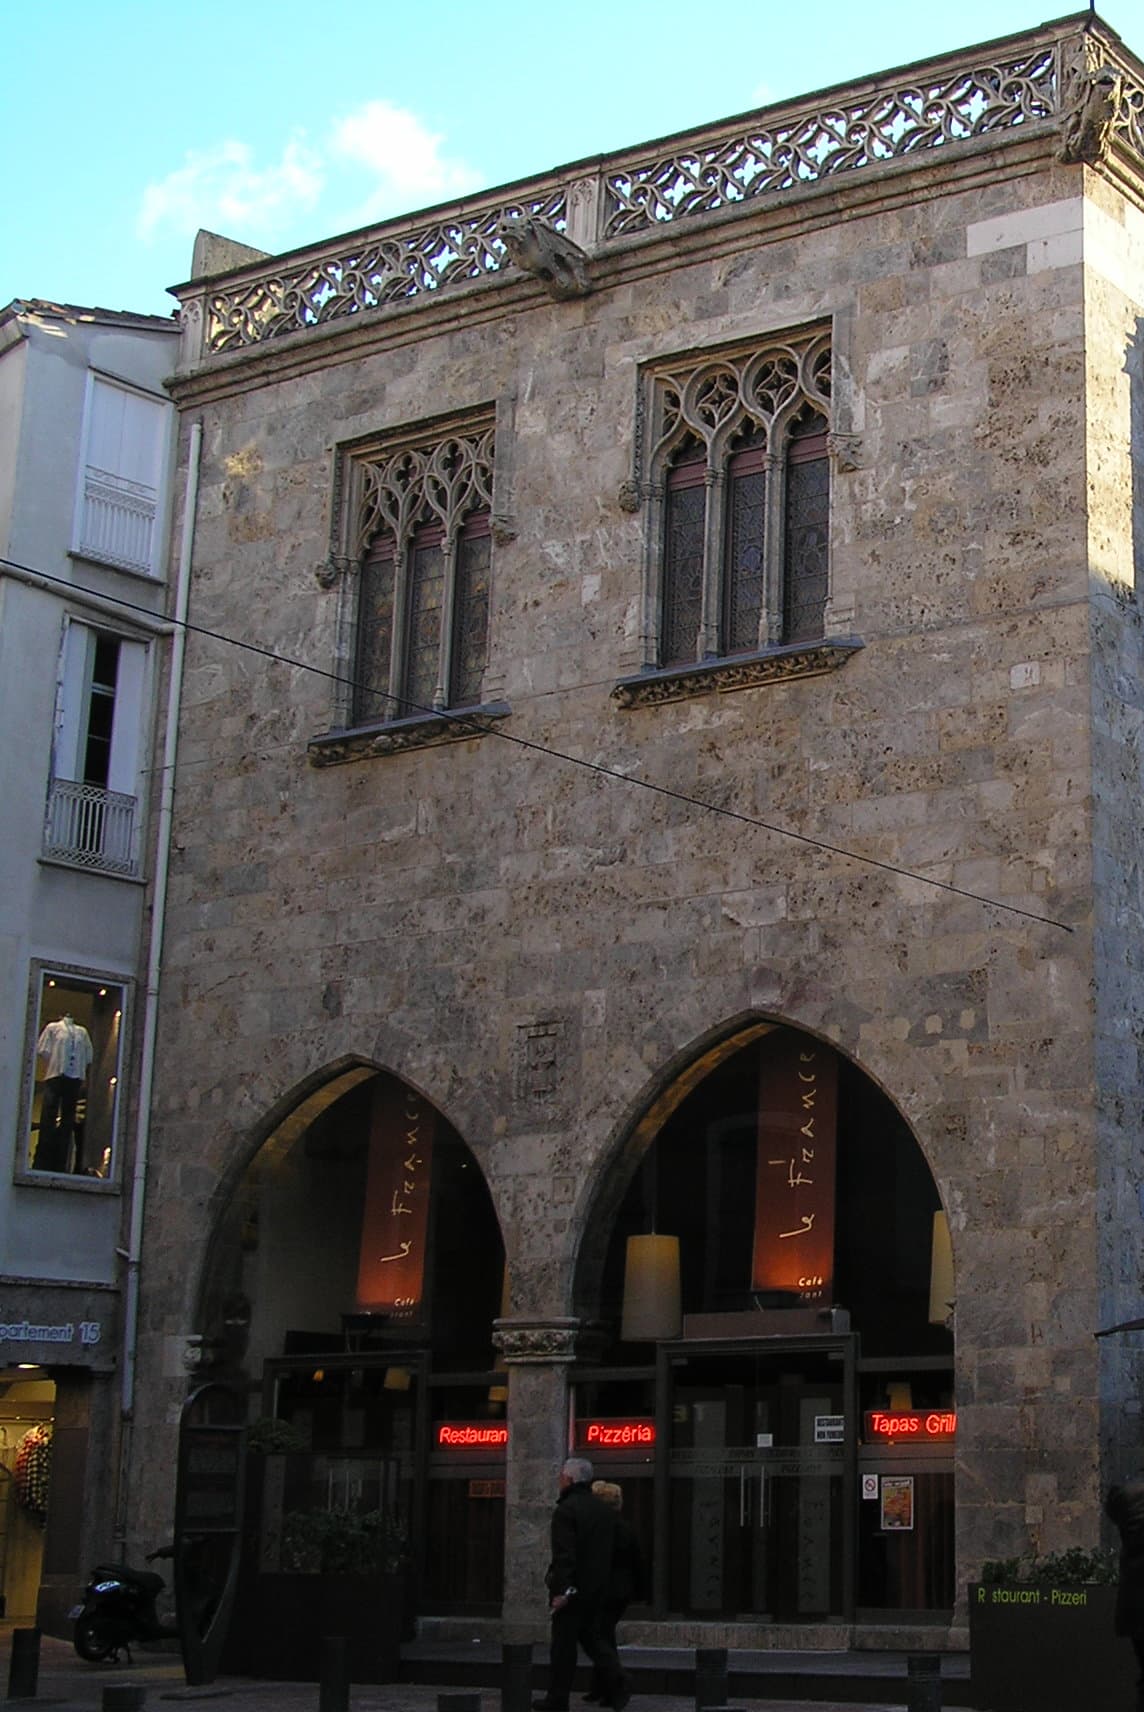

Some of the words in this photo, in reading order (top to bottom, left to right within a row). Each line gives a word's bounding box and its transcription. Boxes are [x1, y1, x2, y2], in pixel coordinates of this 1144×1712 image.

[79, 1321, 101, 1344] 15
[872, 1414, 919, 1436] Tapas
[925, 1413, 957, 1434] Grill
[977, 1587, 1040, 1604] Rstaurant
